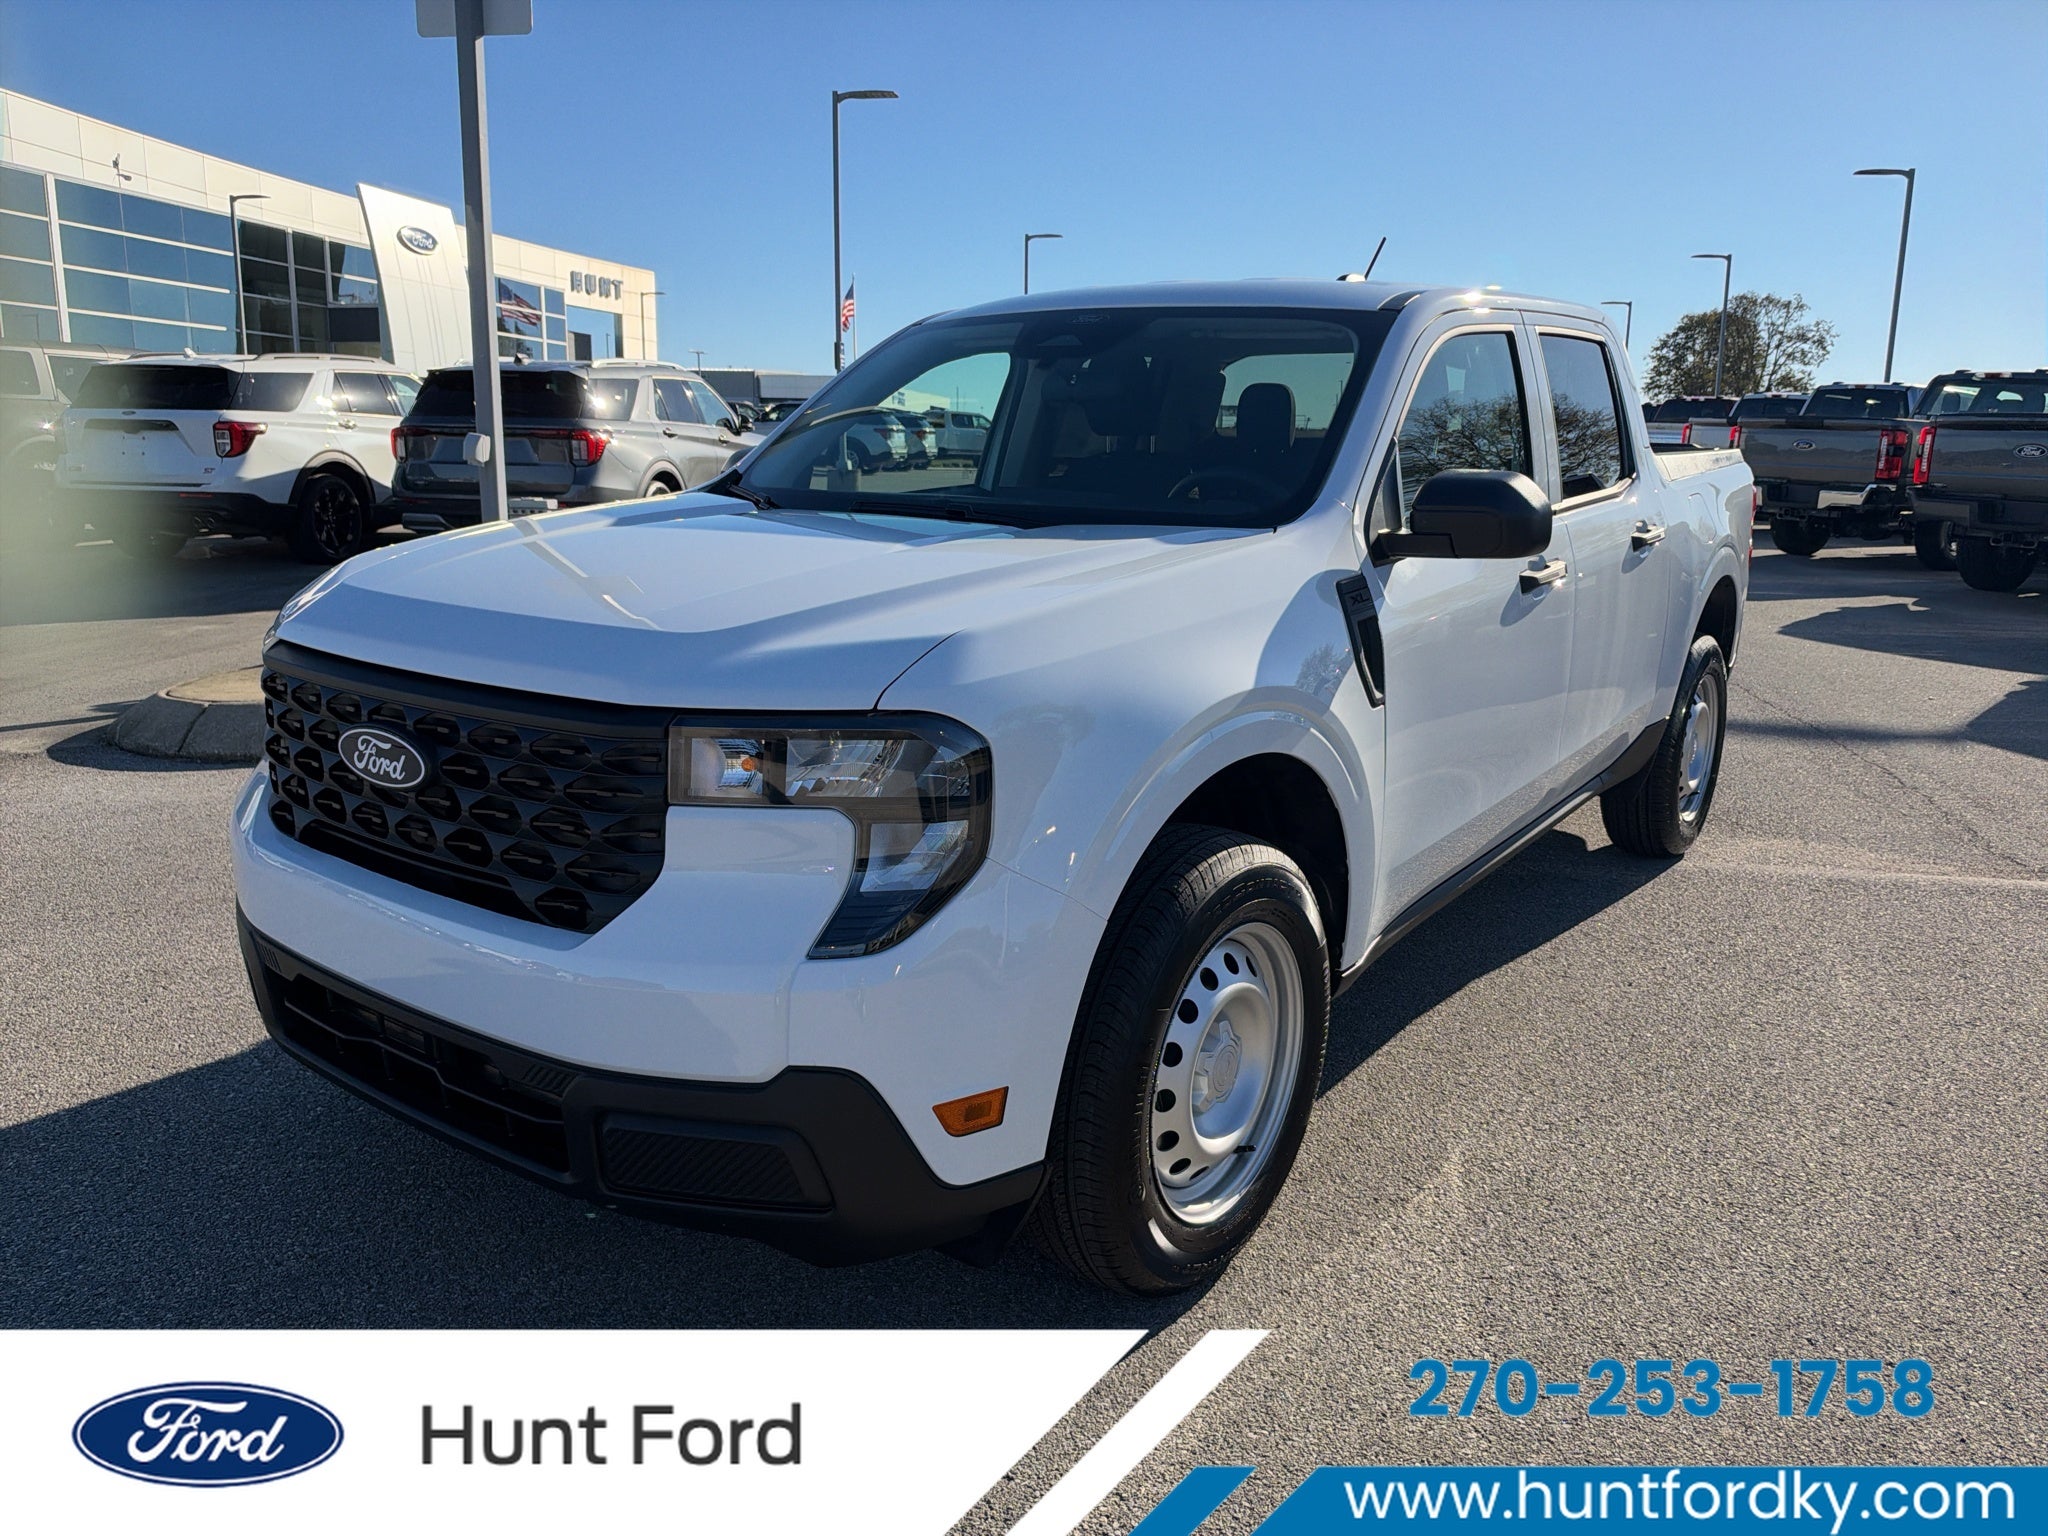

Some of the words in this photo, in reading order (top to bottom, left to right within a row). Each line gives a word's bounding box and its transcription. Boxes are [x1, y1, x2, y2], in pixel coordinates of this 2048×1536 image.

[570, 271, 623, 300] HUNT
[1350, 592, 1370, 606] XL
[353, 735, 406, 780] Ford
